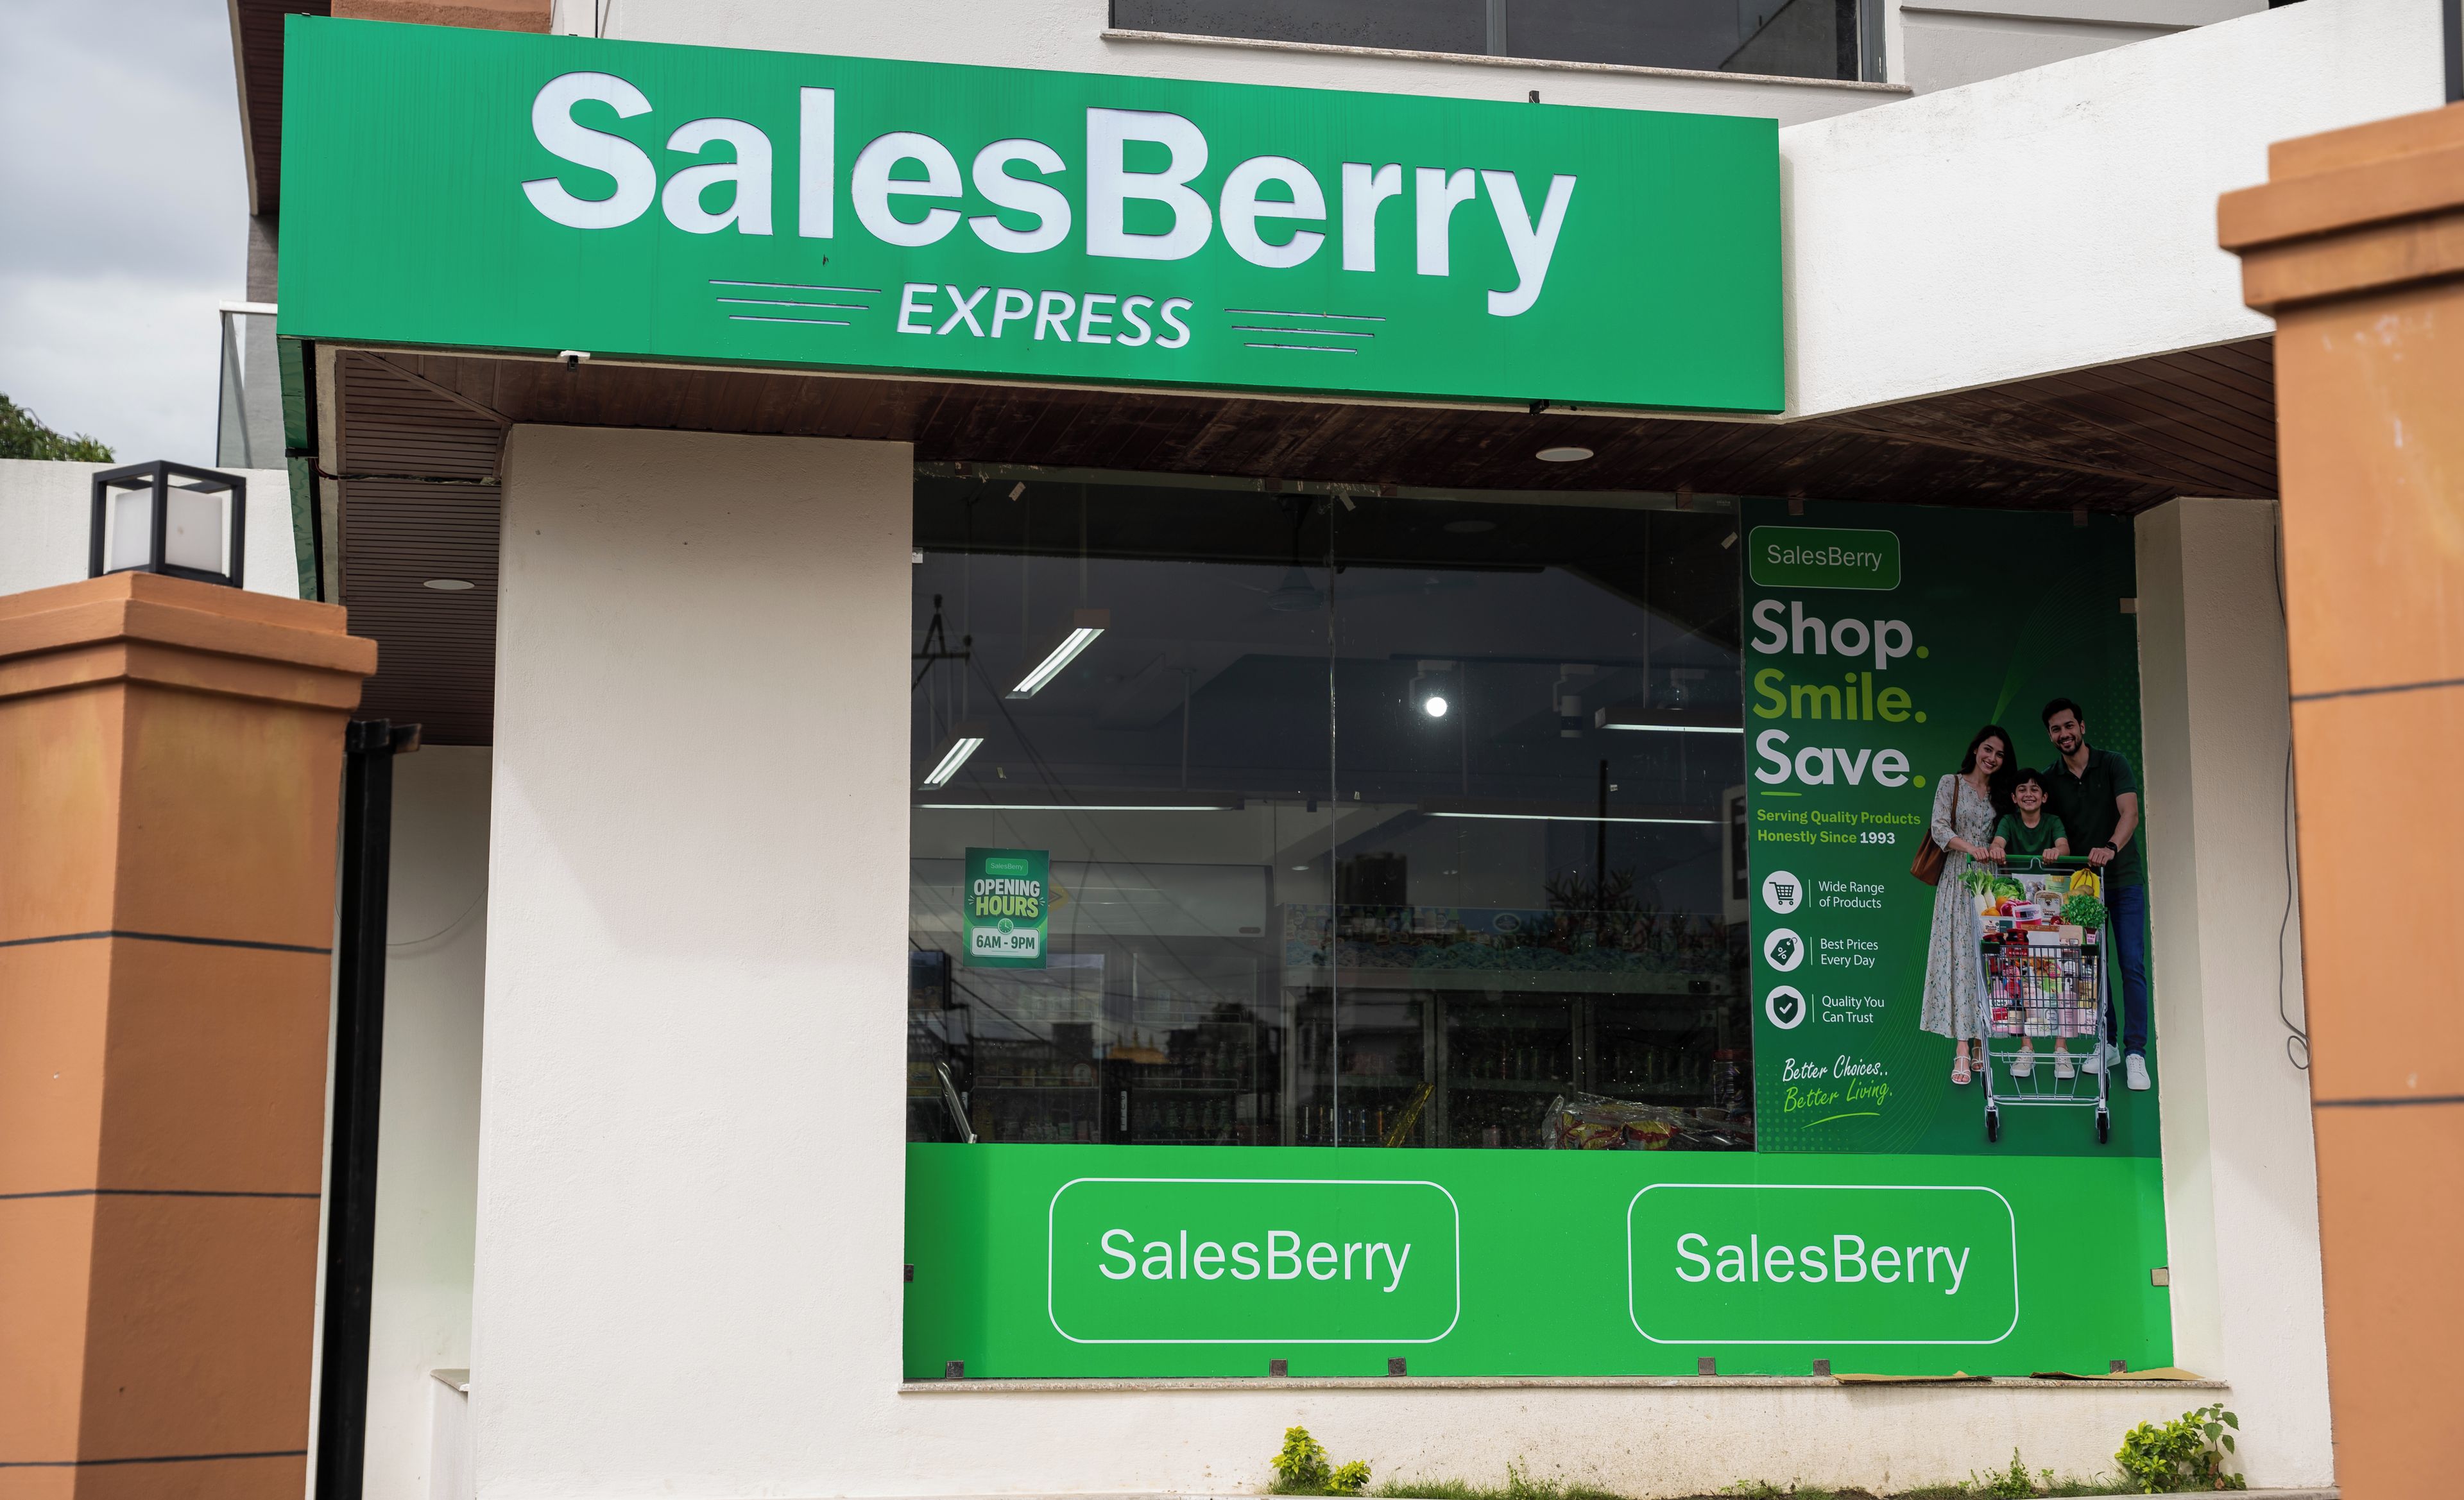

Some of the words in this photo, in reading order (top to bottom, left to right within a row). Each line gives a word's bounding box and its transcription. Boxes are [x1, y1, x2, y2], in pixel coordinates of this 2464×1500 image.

[522, 72, 1577, 317] SalesBerry
[897, 283, 1195, 349] EXPRESS
[1767, 544, 1883, 572] SalesBerry
[1750, 599, 1929, 670] Shop.
[1752, 668, 1927, 723] Smile.
[1754, 728, 1926, 788] Save.
[1757, 809, 1808, 825] Serving
[1811, 810, 1858, 826] Quality
[1861, 811, 1921, 825] Products
[1758, 829, 1817, 845] Honestly
[1820, 831, 1856, 843] Since
[1860, 831, 1895, 845] 1993
[990, 862, 1023, 872] SalesBerry
[973, 879, 1040, 897] OPENING
[1818, 881, 1847, 892] Wide
[1849, 881, 1885, 895] Range
[975, 895, 1039, 918] HOURS
[1819, 895, 1831, 908] of
[1833, 896, 1882, 908] Products
[976, 935, 1001, 949] 6AM
[1011, 936, 1035, 950] 9PM
[1820, 938, 1844, 950] Best
[1847, 938, 1879, 950] Prices
[1821, 954, 1851, 968] Every
[1854, 954, 1876, 969] Day
[1822, 995, 1862, 1010] Quality
[1863, 996, 1885, 1008] You
[1822, 1011, 1844, 1022] Can
[1845, 1012, 1874, 1023] Trust
[1783, 1058, 1828, 1082] Better
[1784, 1087, 1839, 1112] Better
[1846, 1078, 1893, 1105] Living.
[1099, 1228, 1411, 1293] SalesBerry
[1675, 1232, 1970, 1295] SalesBerry
